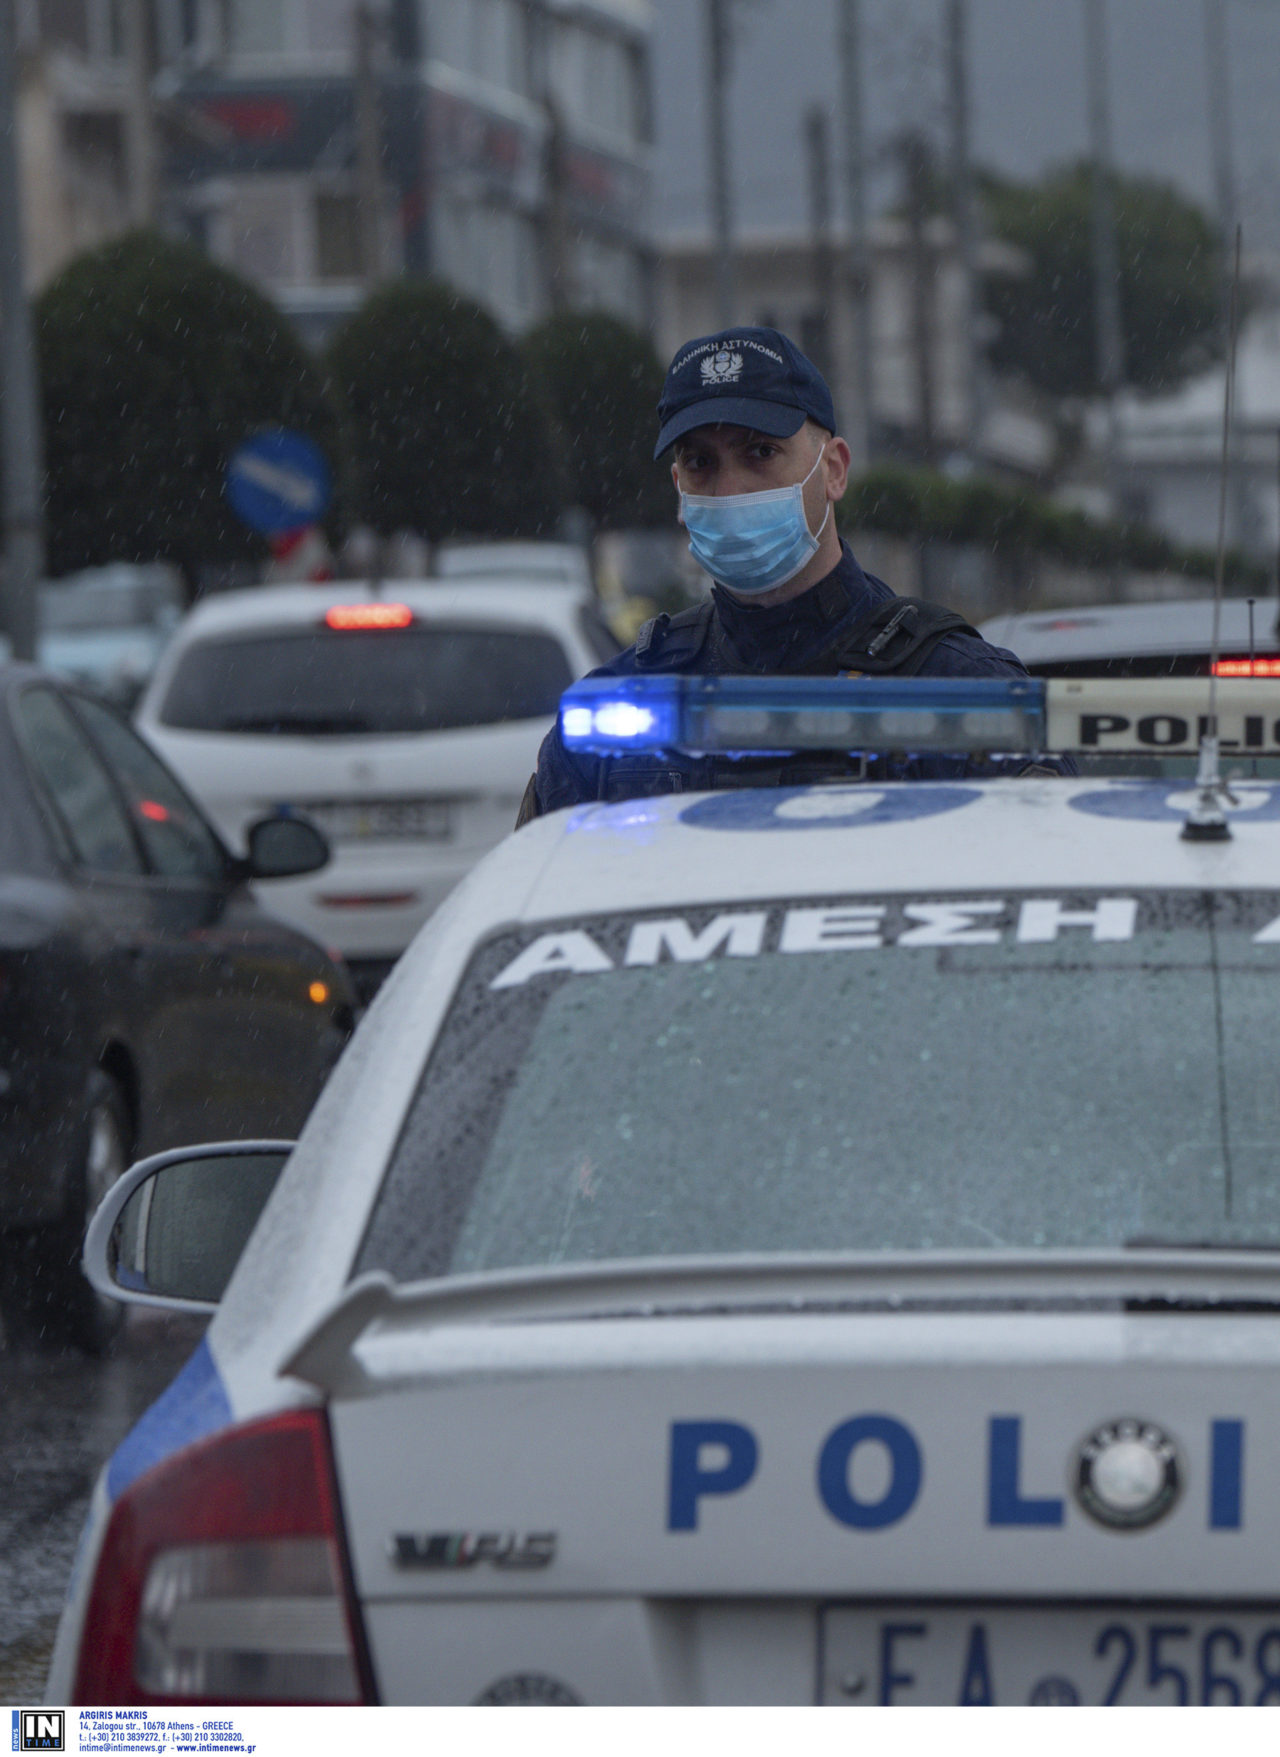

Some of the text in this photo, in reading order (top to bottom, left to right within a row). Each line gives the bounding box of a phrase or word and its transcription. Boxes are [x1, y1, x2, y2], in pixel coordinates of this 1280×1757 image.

[721, 339, 784, 365] ΑΣΤΥΝΟΜΙΑ
[702, 375, 740, 387] POLICE
[490, 898, 1138, 989] ΑΜΕΣΗ
